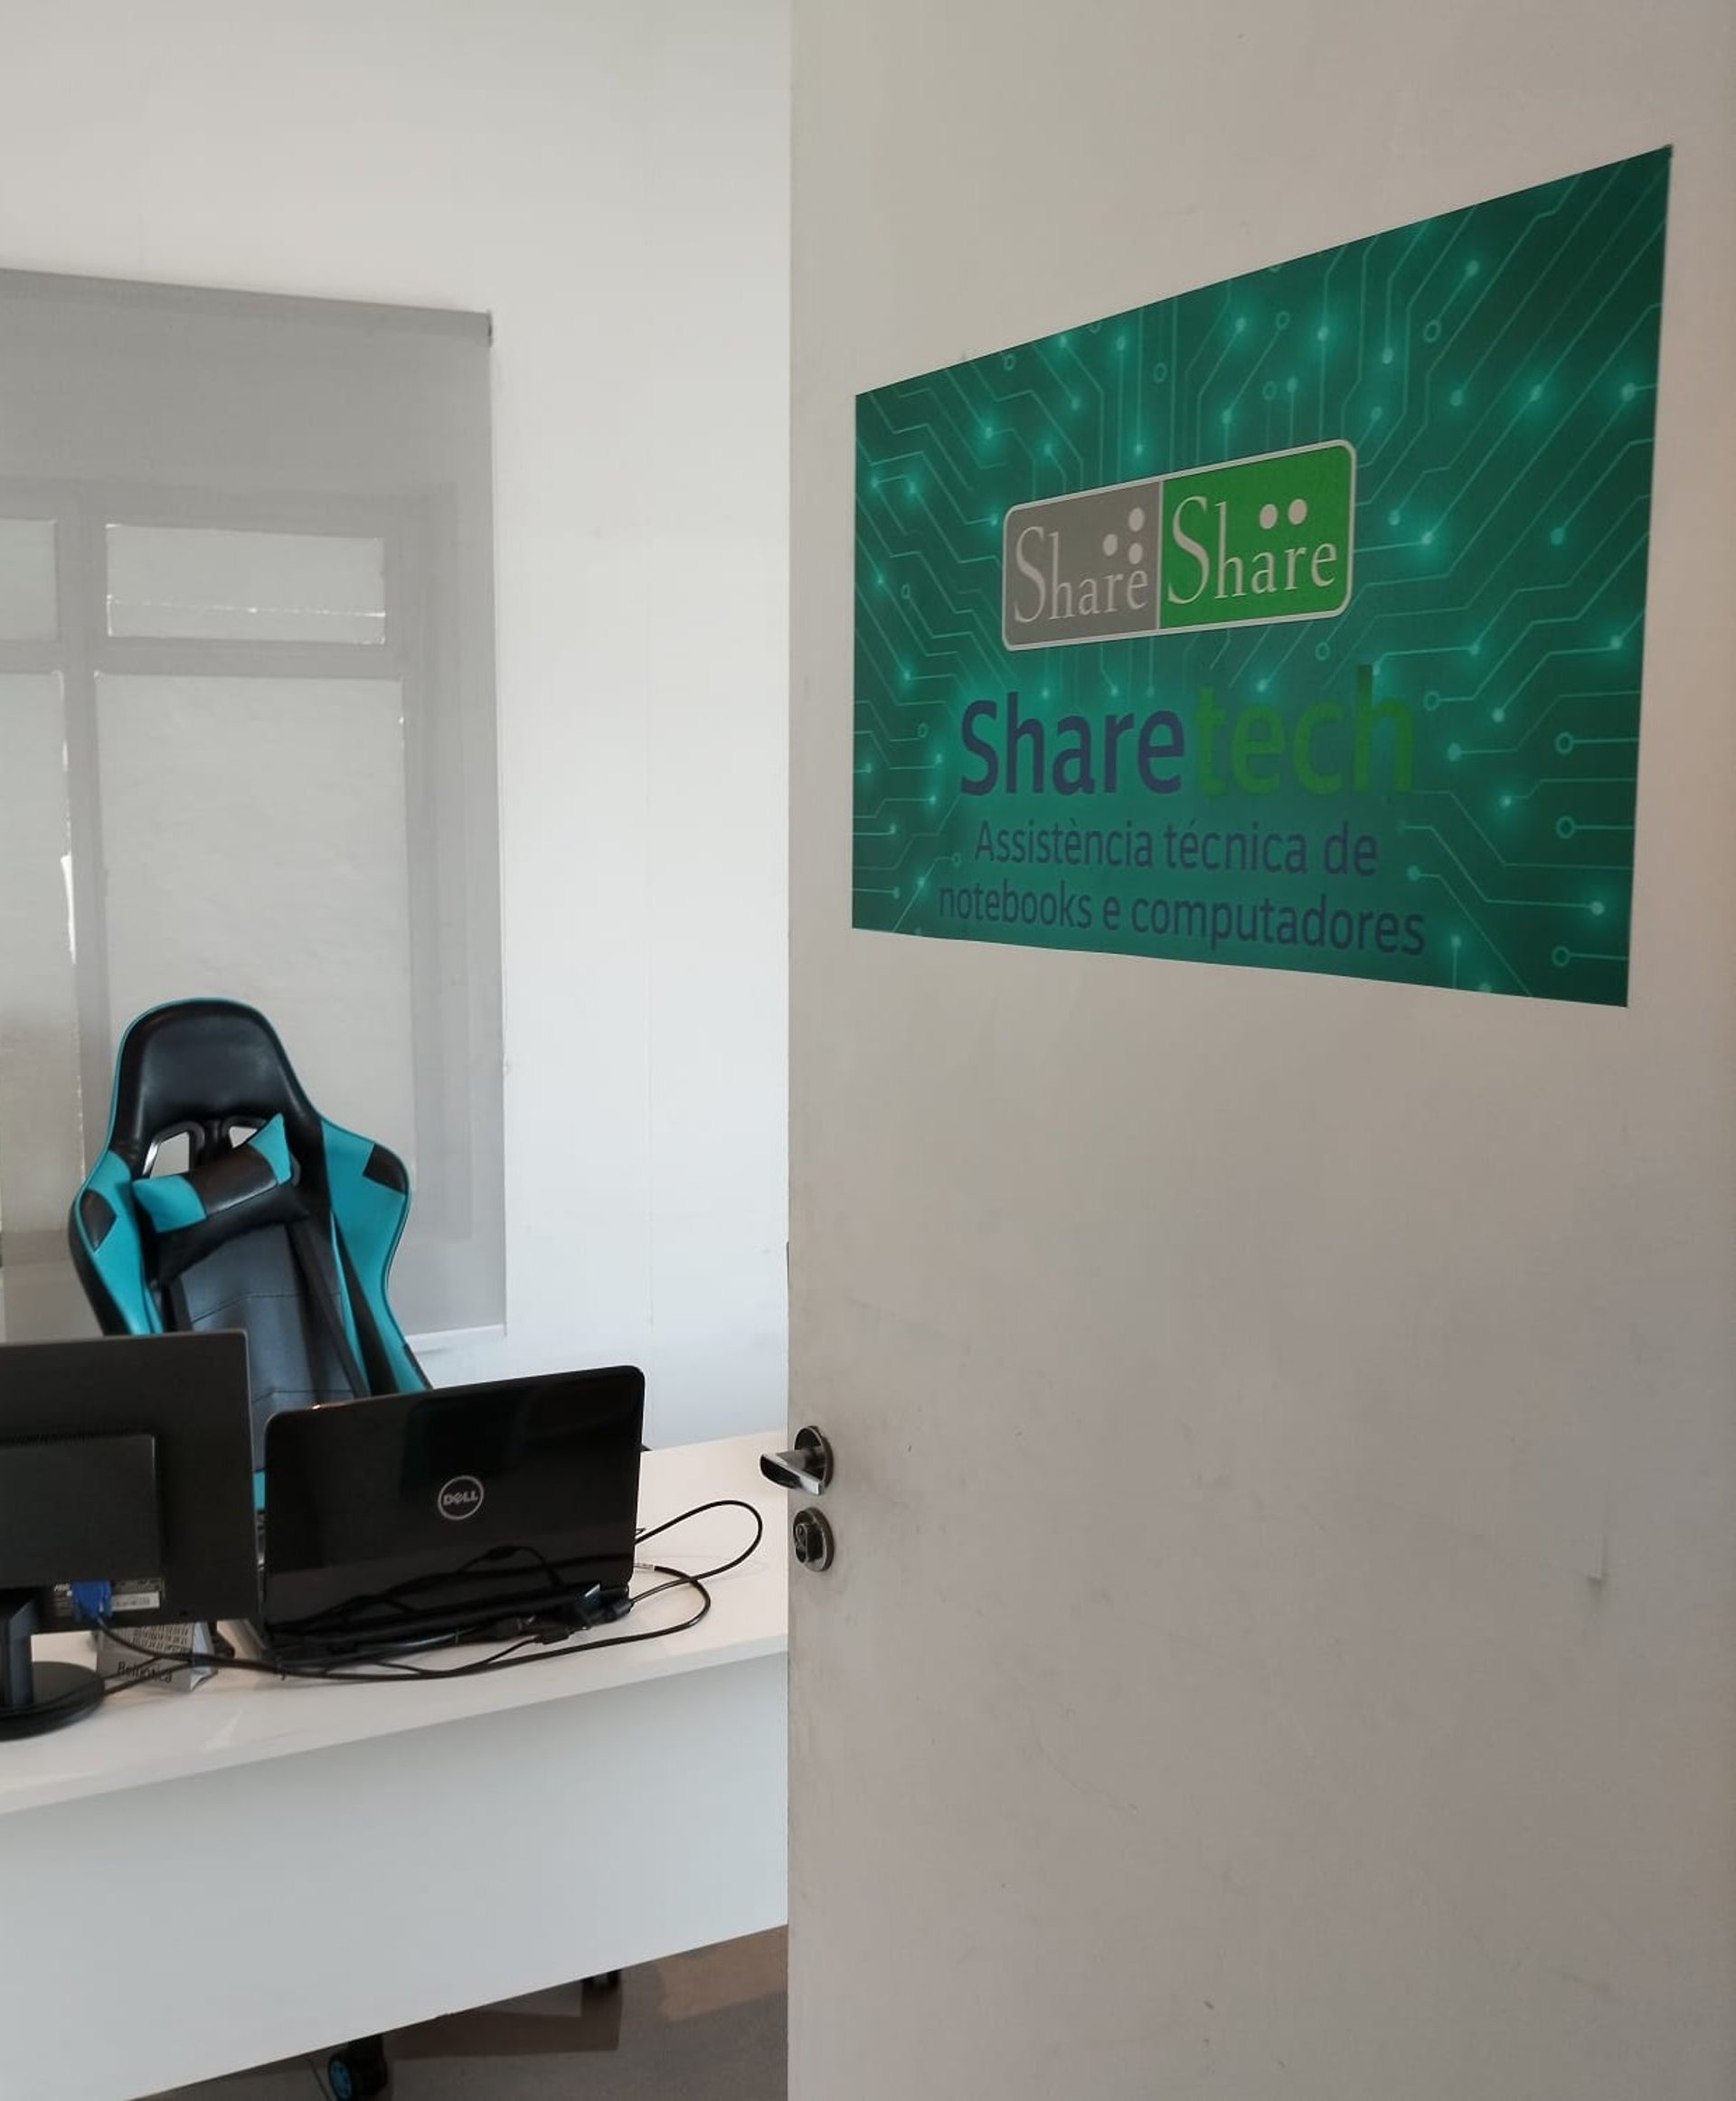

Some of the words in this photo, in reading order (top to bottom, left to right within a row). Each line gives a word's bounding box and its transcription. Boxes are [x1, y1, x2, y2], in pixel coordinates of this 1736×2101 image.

[1014, 525, 1149, 624] Share
[1167, 495, 1337, 605] Share
[1163, 818, 1307, 873] técnica
[1323, 820, 1379, 877] de
[939, 879, 1092, 929] notebooks
[1102, 896, 1121, 931] e
[1131, 893, 1426, 956] computadores
[443, 1490, 478, 1506] DELL
